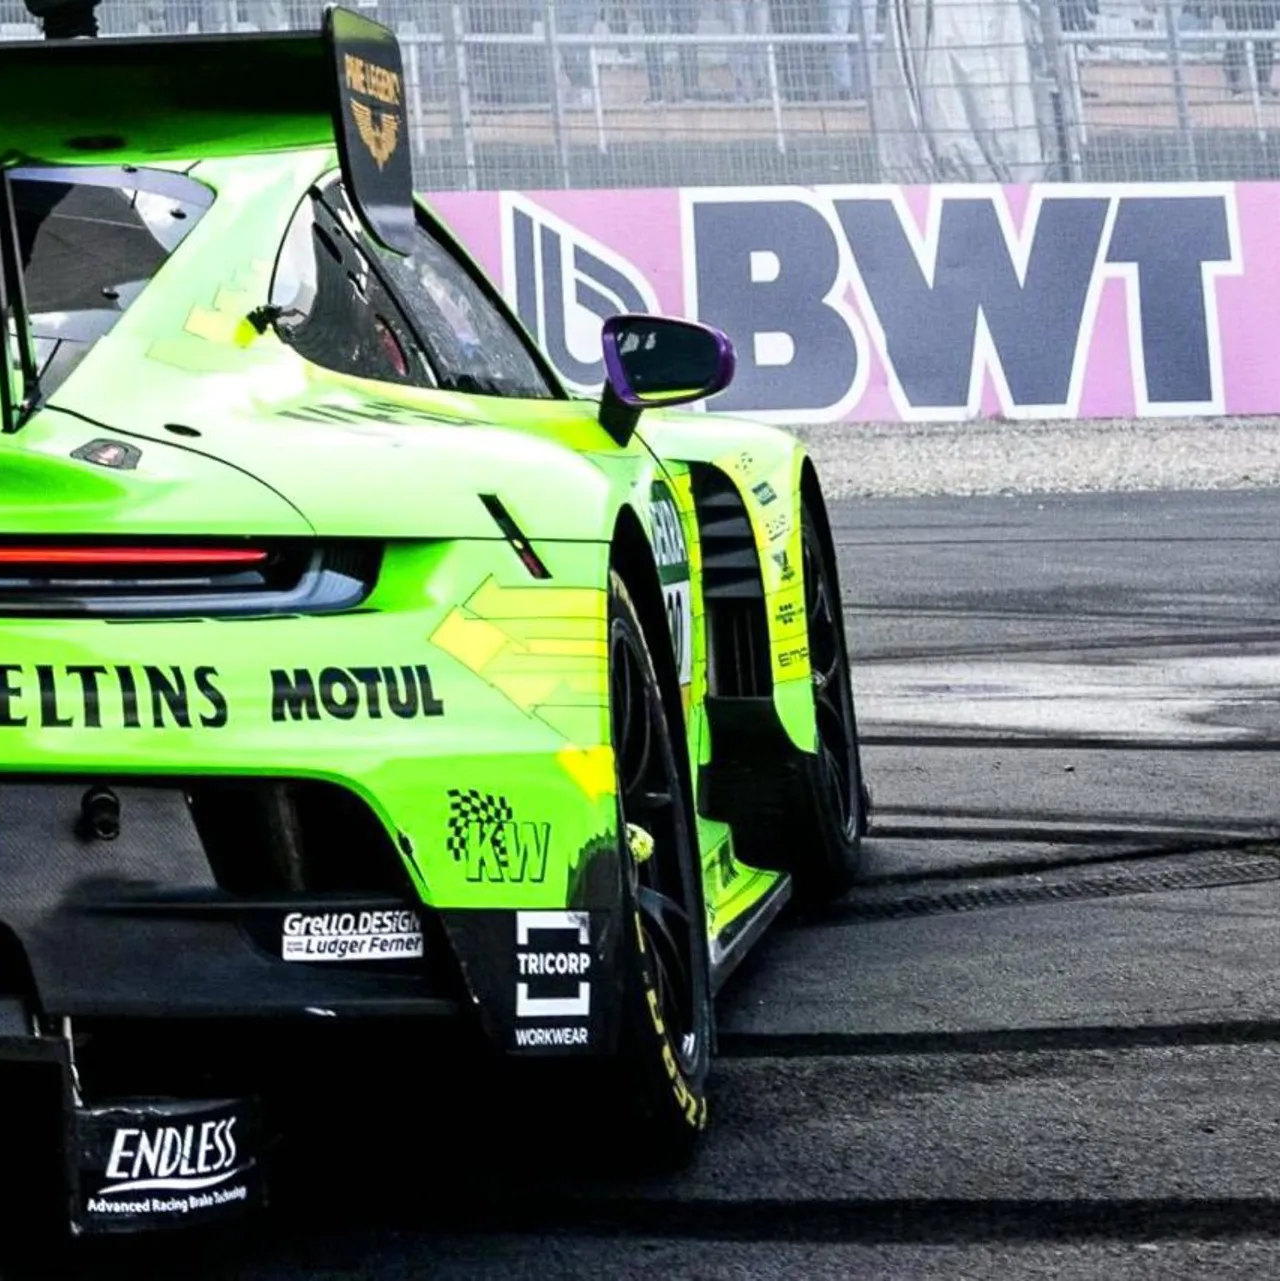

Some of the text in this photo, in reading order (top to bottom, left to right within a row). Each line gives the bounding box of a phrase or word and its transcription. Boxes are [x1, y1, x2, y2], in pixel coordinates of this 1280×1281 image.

[686, 190, 1238, 416] BWT
[270, 664, 445, 723] MOTUL
[465, 820, 551, 883] KW
[305, 938, 366, 958] Ludger
[368, 936, 422, 953] Ferner
[516, 952, 591, 975] TRICORP
[515, 1027, 589, 1047] WORKWEAR
[105, 1115, 237, 1179] ENDLESS
[87, 1198, 151, 1213] Advanced
[152, 1198, 188, 1213] Racing
[189, 1193, 214, 1210] Brake
